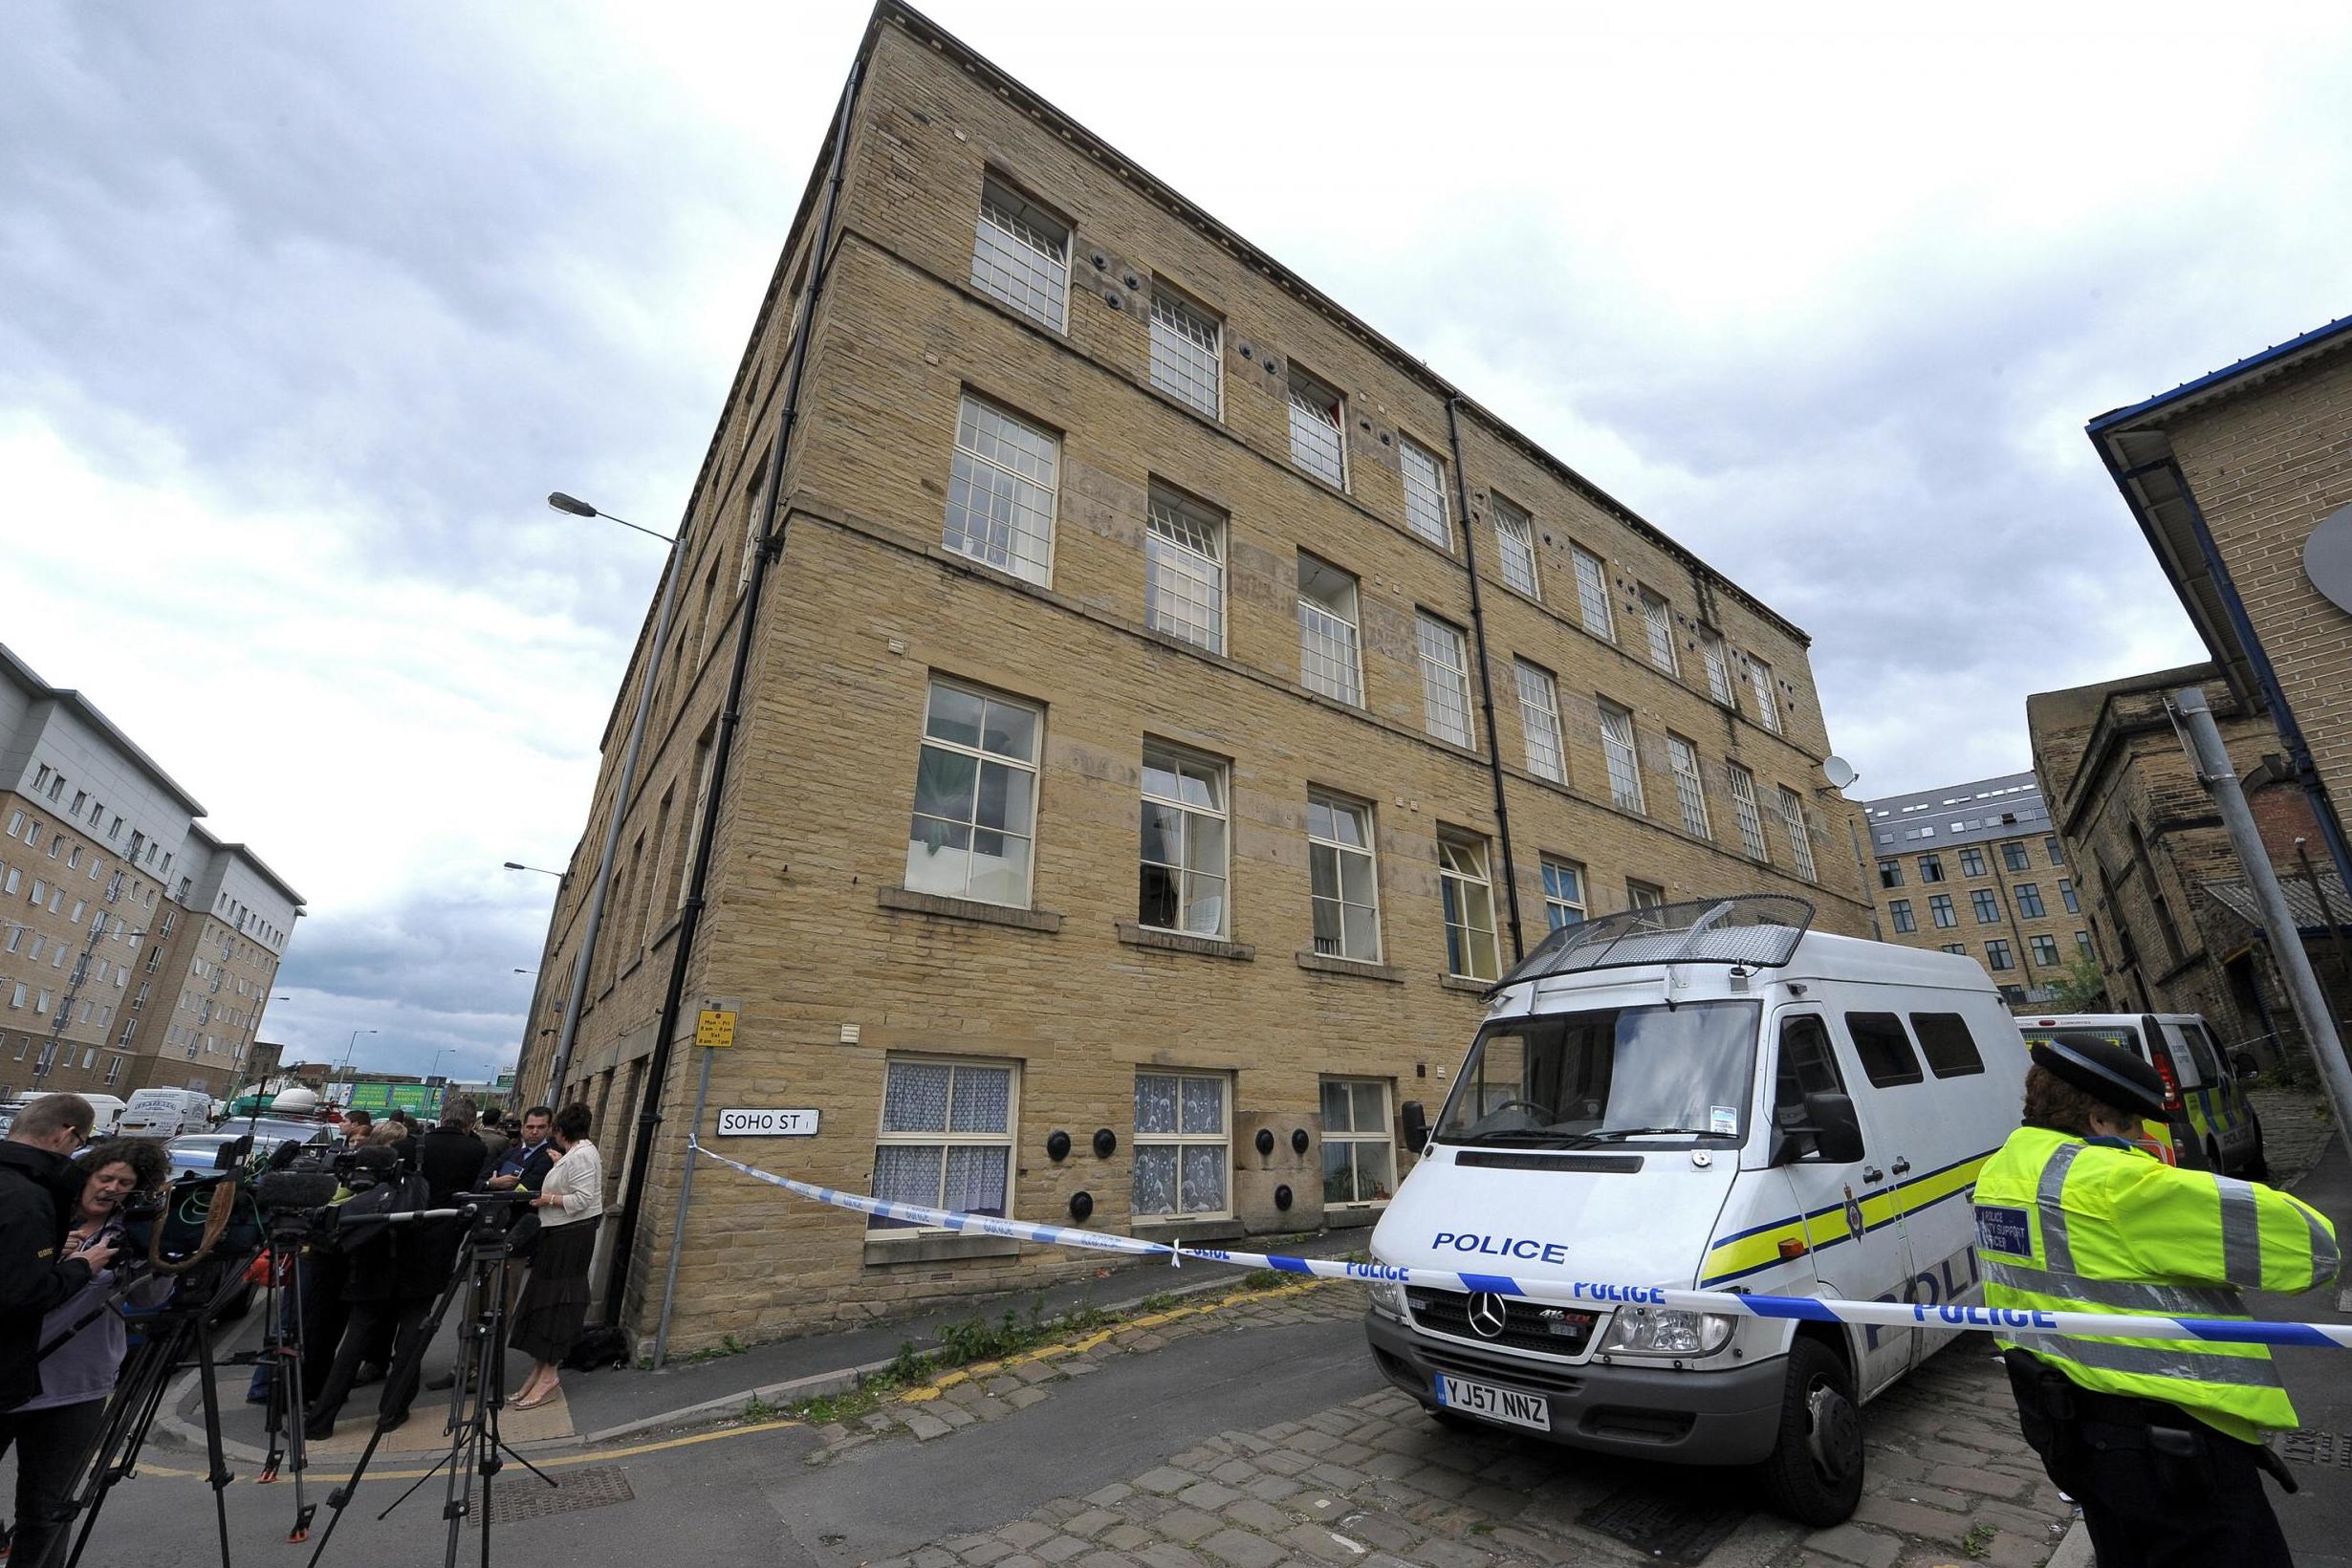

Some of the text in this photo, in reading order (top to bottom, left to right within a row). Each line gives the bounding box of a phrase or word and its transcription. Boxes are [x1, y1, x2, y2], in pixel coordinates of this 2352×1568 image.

[723, 1114, 773, 1129] SOHO
[778, 1115, 800, 1129] ST
[1985, 1210, 2003, 1223] POLICE
[1996, 1225, 2025, 1238] SUPPORT
[1431, 1232, 1569, 1265] POLICE
[1346, 1263, 1410, 1282] POLICE
[1574, 1281, 1666, 1305] POLICE
[1864, 1245, 1979, 1353] POLI
[1539, 1309, 1565, 1320] 416
[1914, 1303, 2058, 1330] POLICE
[1447, 1379, 1545, 1424] YJ57 NNZ
